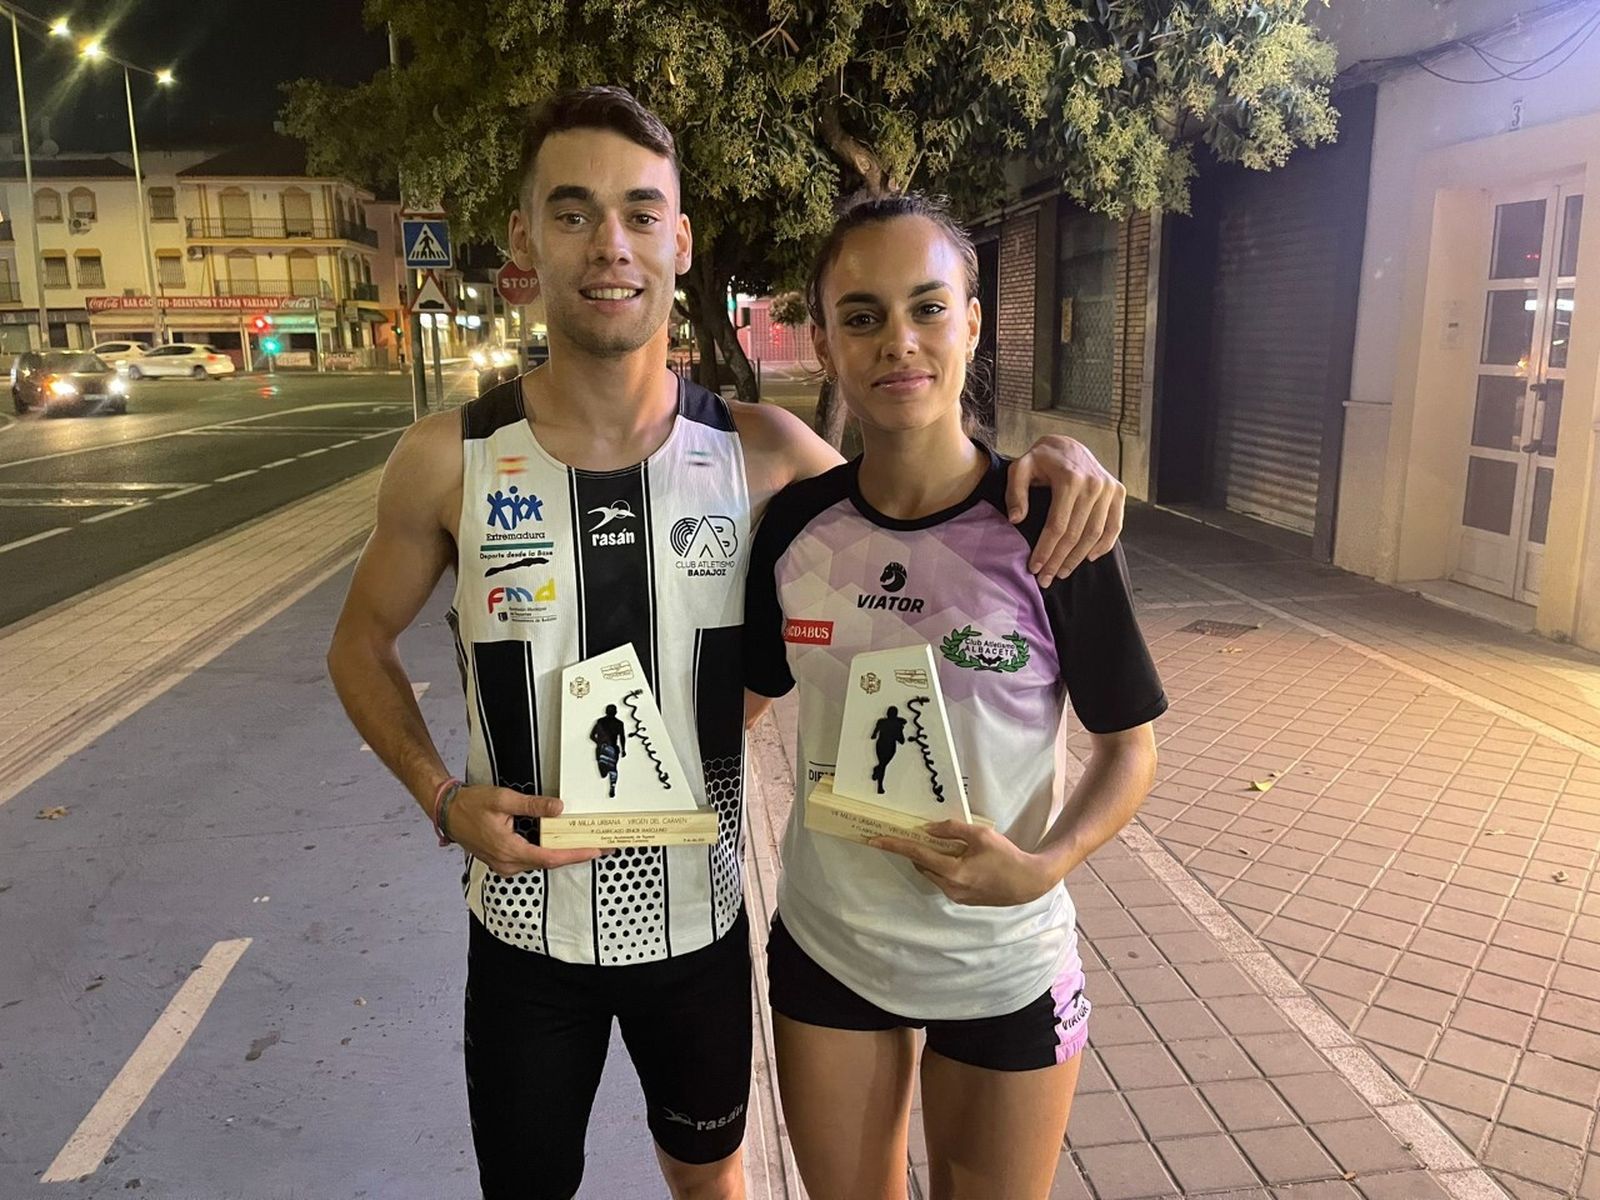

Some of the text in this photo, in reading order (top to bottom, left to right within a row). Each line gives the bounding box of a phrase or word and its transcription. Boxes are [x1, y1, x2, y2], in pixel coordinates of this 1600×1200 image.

[502, 277, 538, 288] STOP
[486, 531, 545, 541] Extremadura
[592, 528, 635, 546] rasán
[480, 552, 504, 560] Deporte
[675, 560, 735, 569] CLUB ATLETISMO
[687, 568, 727, 576] BADAJOZ
[857, 594, 925, 613] VIATOR
[965, 638, 1015, 650] Club Atletismo
[965, 645, 1015, 657] ALBACETE
